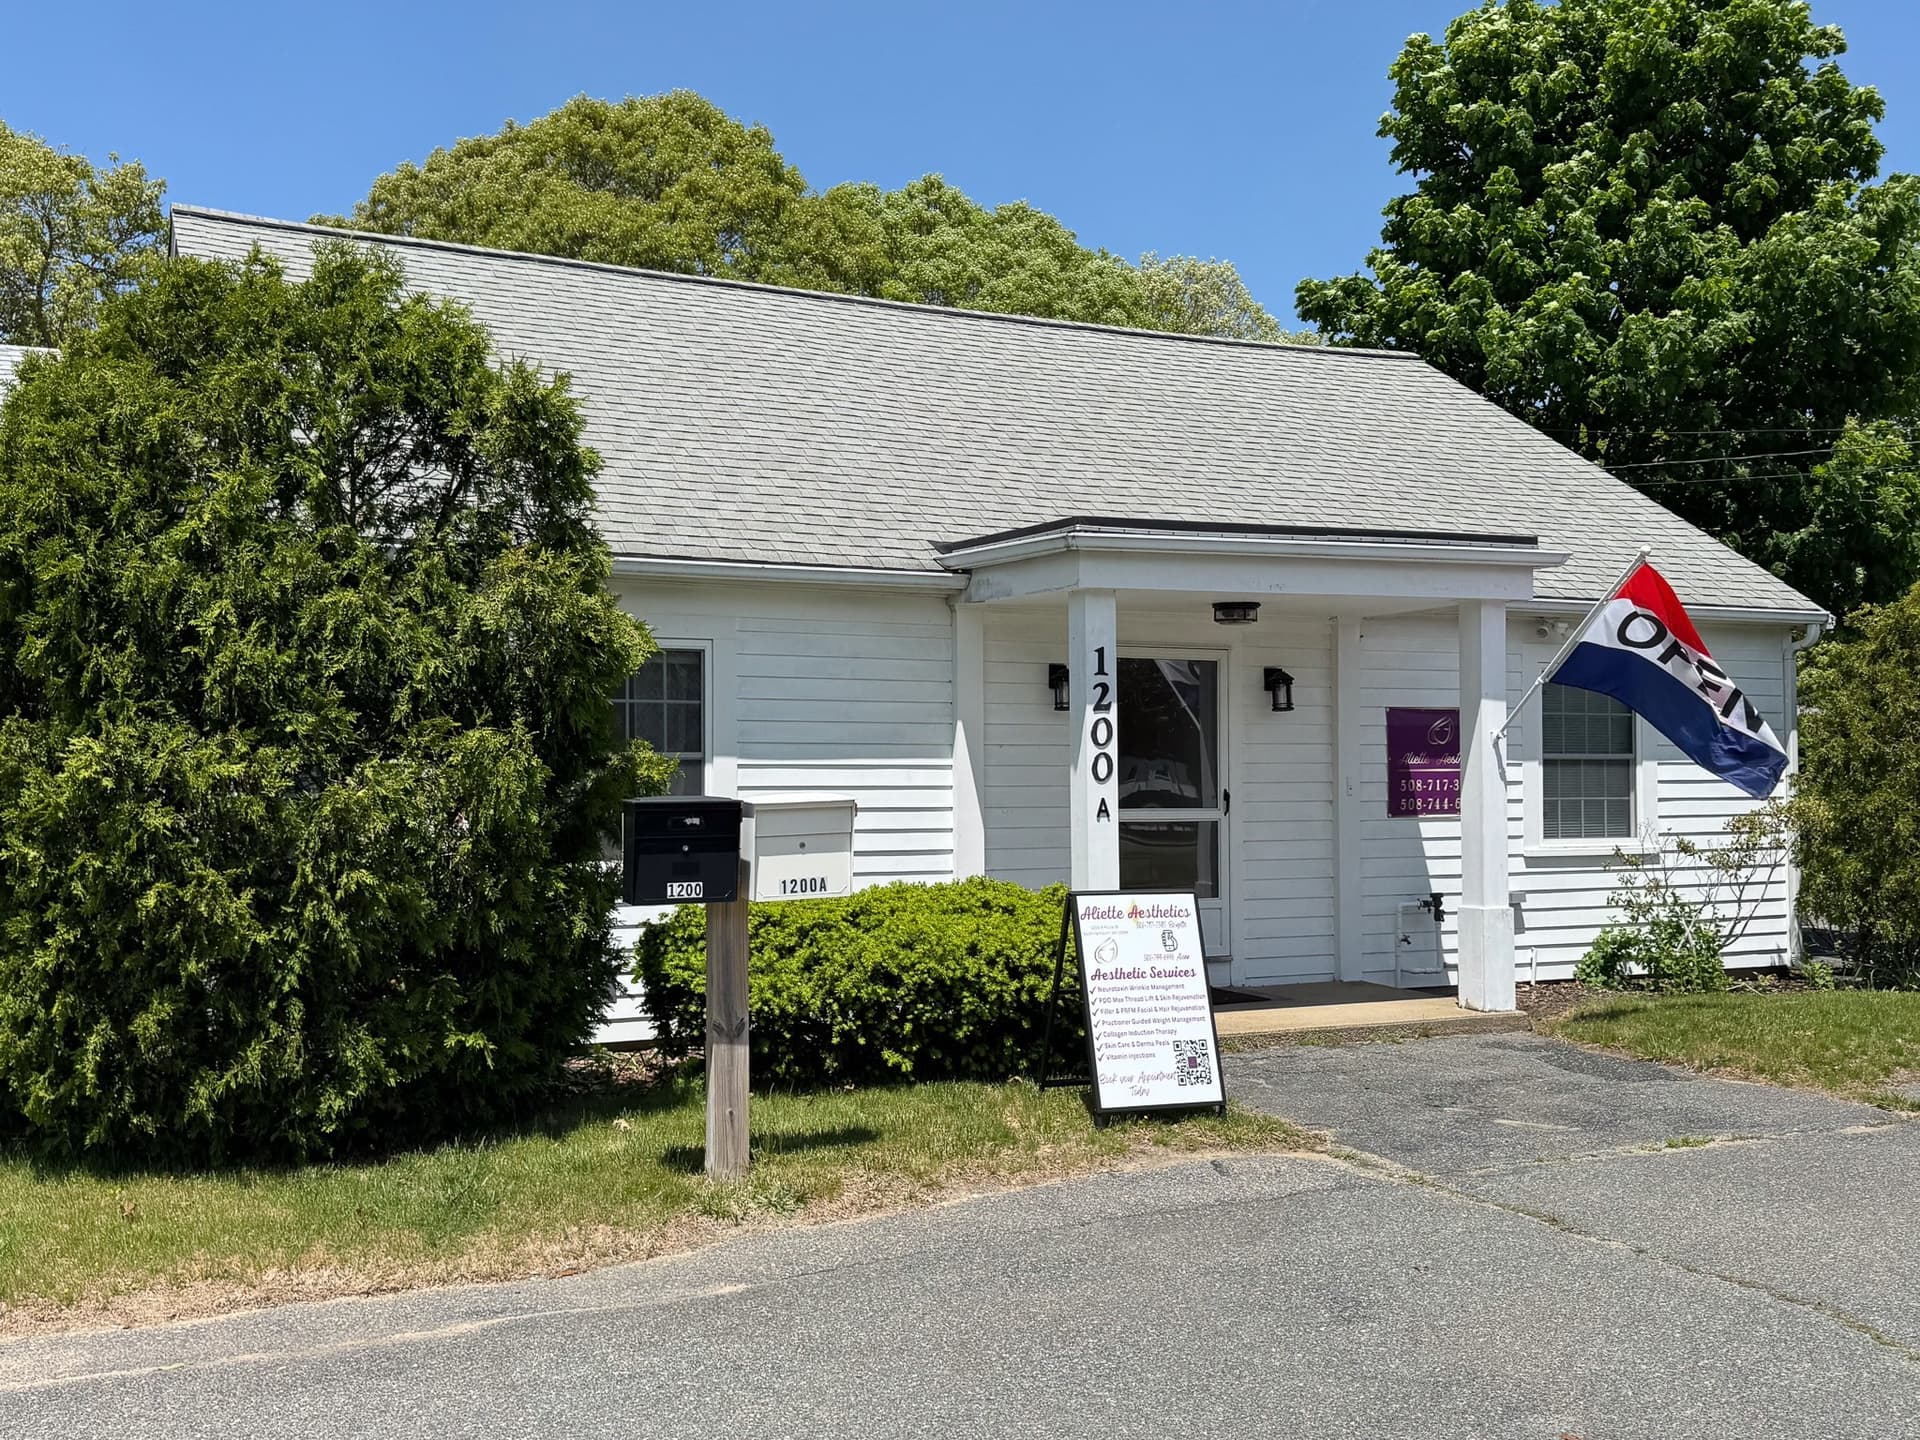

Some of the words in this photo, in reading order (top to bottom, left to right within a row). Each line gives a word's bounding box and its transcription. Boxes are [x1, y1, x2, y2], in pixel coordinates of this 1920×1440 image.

[1400, 779, 1460, 791] 508-717-3
[1400, 797, 1461, 810] 508-744-6
[668, 883, 702, 897] 1200
[781, 877, 827, 894] 1200A
[1080, 905, 1124, 920] Aliette
[1127, 904, 1191, 919] Aesthetics
[1091, 967, 1147, 981] Aesthetic
[1150, 966, 1197, 979] Services
[1150, 983, 1185, 991] Management
[1172, 994, 1206, 1002] Rejuvenation
[1170, 1005, 1206, 1014] Rejuvenation
[1171, 1016, 1206, 1024] Management
